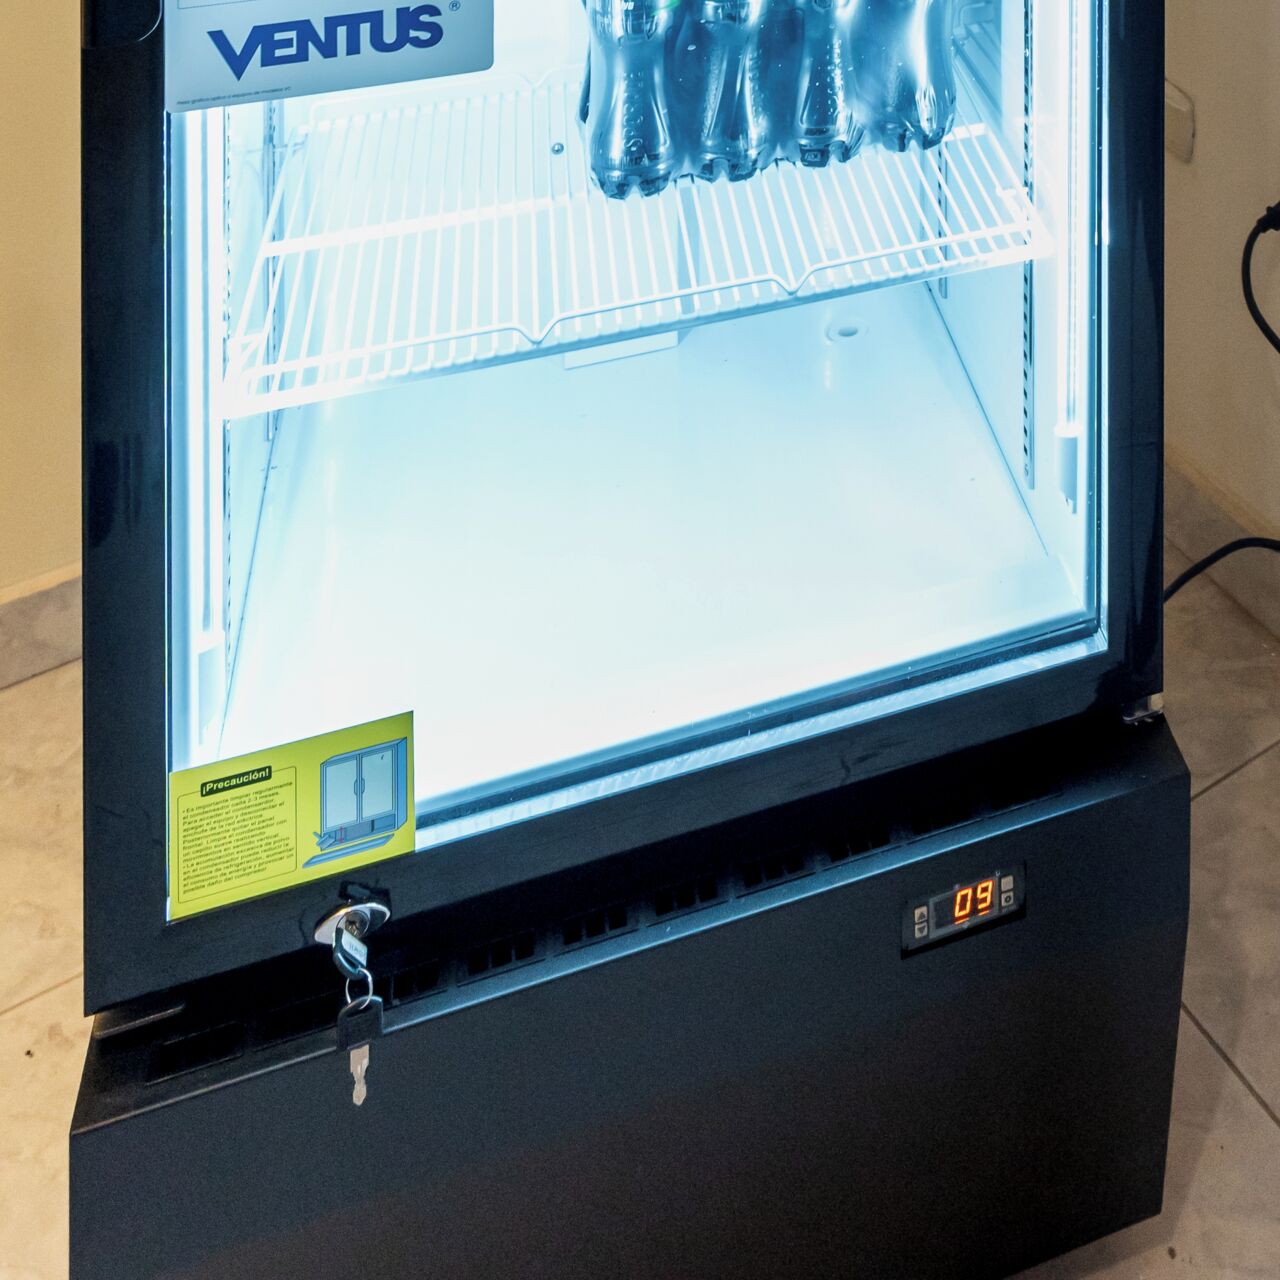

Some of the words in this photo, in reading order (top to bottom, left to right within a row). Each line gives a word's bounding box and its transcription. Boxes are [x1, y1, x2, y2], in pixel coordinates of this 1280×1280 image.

[207, 4, 444, 82] VENTUS
[202, 769, 269, 795] ¡Precaución!
[954, 879, 993, 918] 09
